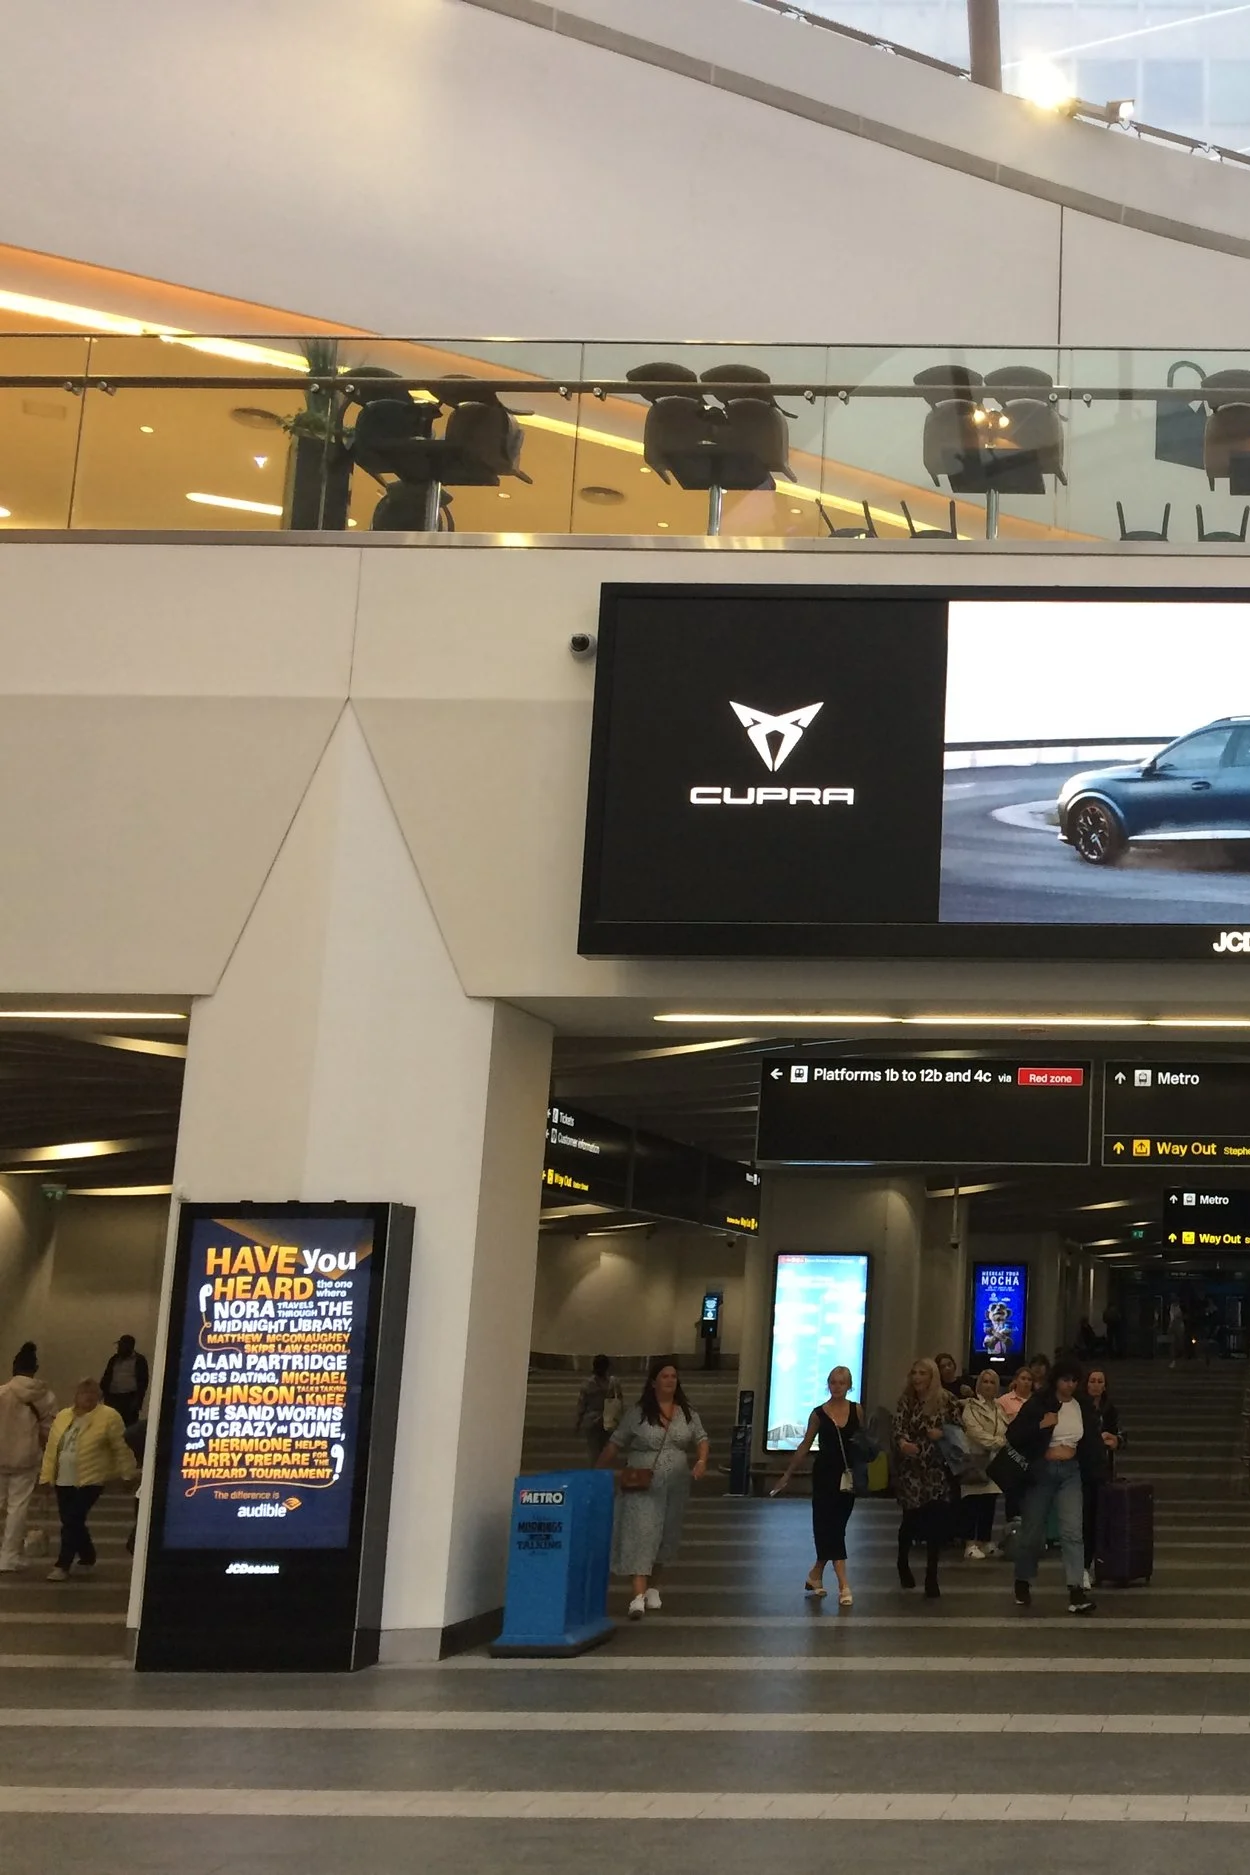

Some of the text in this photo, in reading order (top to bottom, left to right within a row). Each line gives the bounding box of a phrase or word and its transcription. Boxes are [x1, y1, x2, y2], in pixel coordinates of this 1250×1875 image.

[690, 786, 855, 806] CUPRA
[813, 1067, 1012, 1084] Platforms 1b to 12b and 4c via
[1029, 1074, 1073, 1085] Red zone
[1157, 1071, 1200, 1086] Metro
[1156, 1142, 1217, 1157] Way Out
[1199, 1194, 1230, 1205] Metro
[1199, 1233, 1242, 1245] Way Out
[206, 1245, 357, 1275] HAVE you
[213, 1276, 314, 1301] HEARD
[316, 1279, 353, 1289] the one
[981, 1276, 1020, 1286] MOCHA
[213, 1300, 275, 1319] NORA
[276, 1301, 315, 1310] TRAVELS
[317, 1300, 354, 1317] THE
[276, 1309, 318, 1318] THROUGH
[213, 1317, 353, 1333] MIDNIGHT LIBRARY,
[207, 1333, 264, 1344] MATTHEW
[244, 1343, 276, 1354] SKIPS
[277, 1343, 302, 1354] LAW
[192, 1352, 348, 1372] ALAN PARTRIDGE
[190, 1371, 348, 1385] GOES DATING, MICHAEL
[187, 1385, 295, 1406] JOHNSON
[296, 1393, 347, 1408] A KNEE,
[188, 1405, 344, 1422] THE SAND WORMS
[186, 1422, 214, 1438] GO
[216, 1421, 278, 1439] CRAZY
[289, 1422, 346, 1442] DUNE,
[208, 1437, 293, 1452] HERMIONE
[294, 1440, 328, 1450] HELPS
[182, 1452, 311, 1467] HARRY PREPARE
[213, 1490, 280, 1500] The difference is
[522, 1492, 563, 1504] METRO
[237, 1504, 287, 1518] audible
